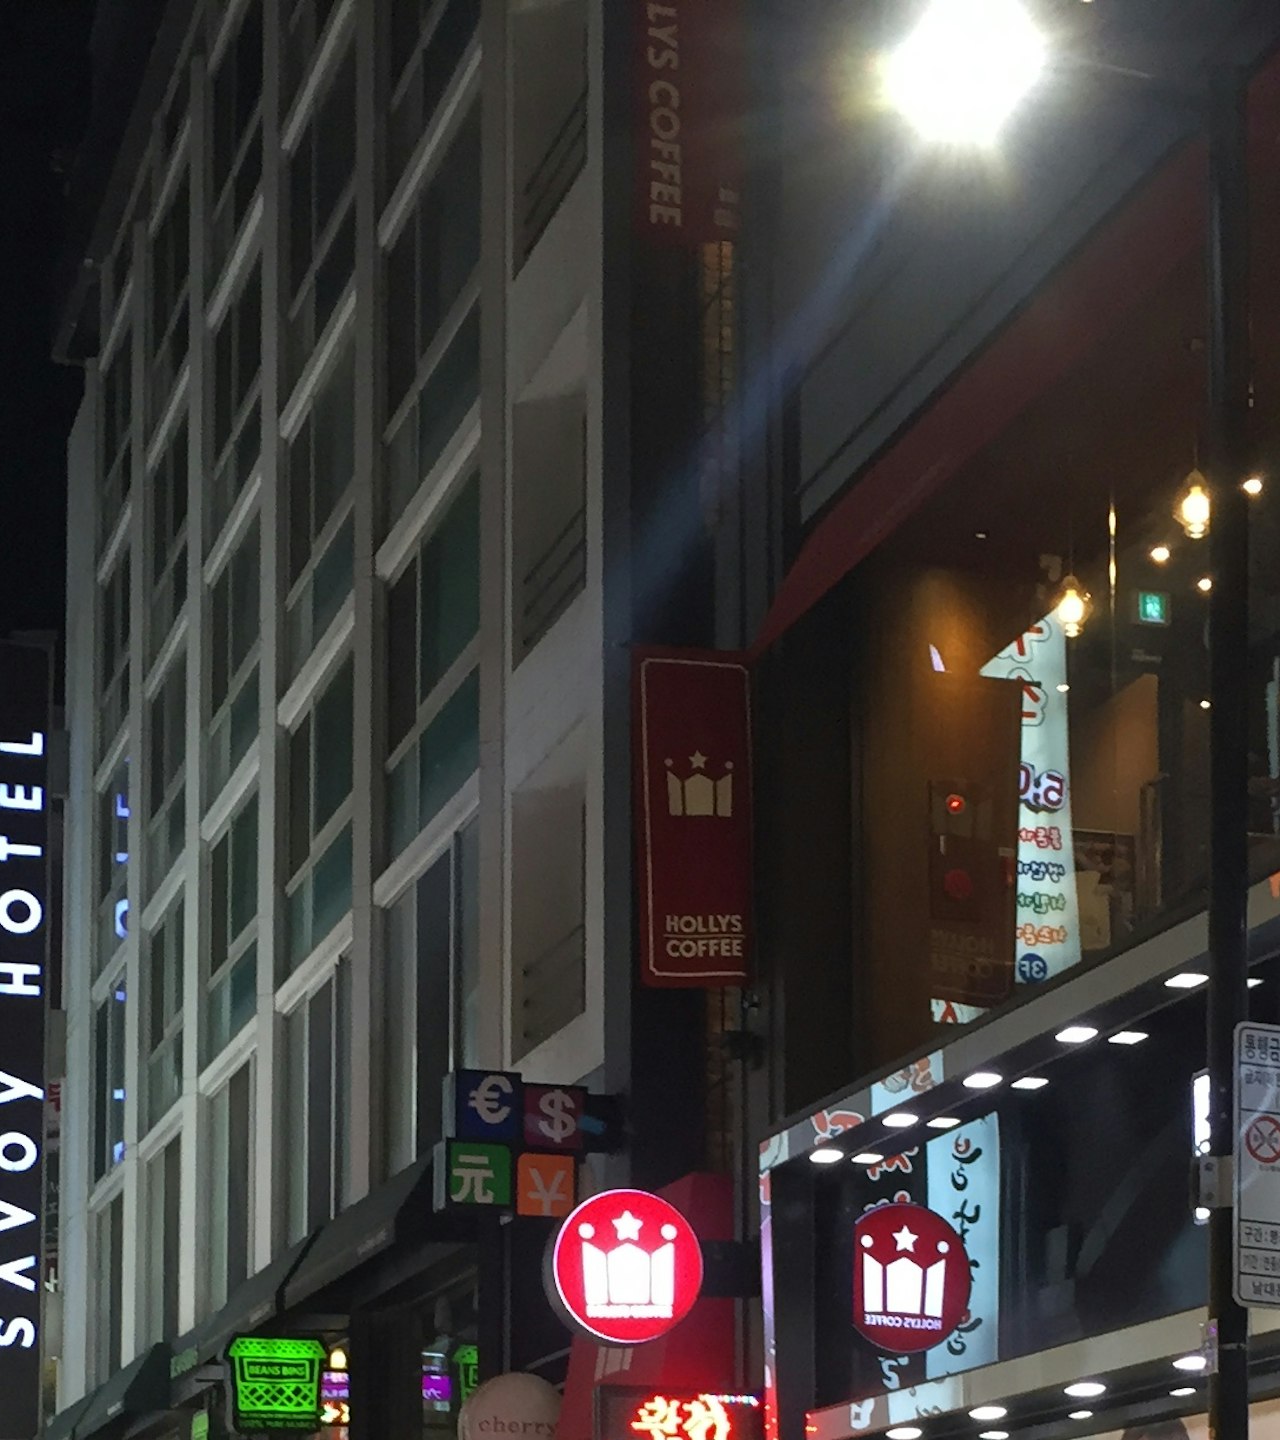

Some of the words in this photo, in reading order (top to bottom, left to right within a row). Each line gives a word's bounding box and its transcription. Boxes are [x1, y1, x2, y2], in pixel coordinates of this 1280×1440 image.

[647, 80, 683, 228] COFFEE
[664, 913, 743, 933] HOLLYS
[664, 938, 743, 959] COFFEE
[450, 1154, 496, 1204] 元
[248, 1364, 281, 1377] BEANS
[477, 1416, 558, 1437] cherry
